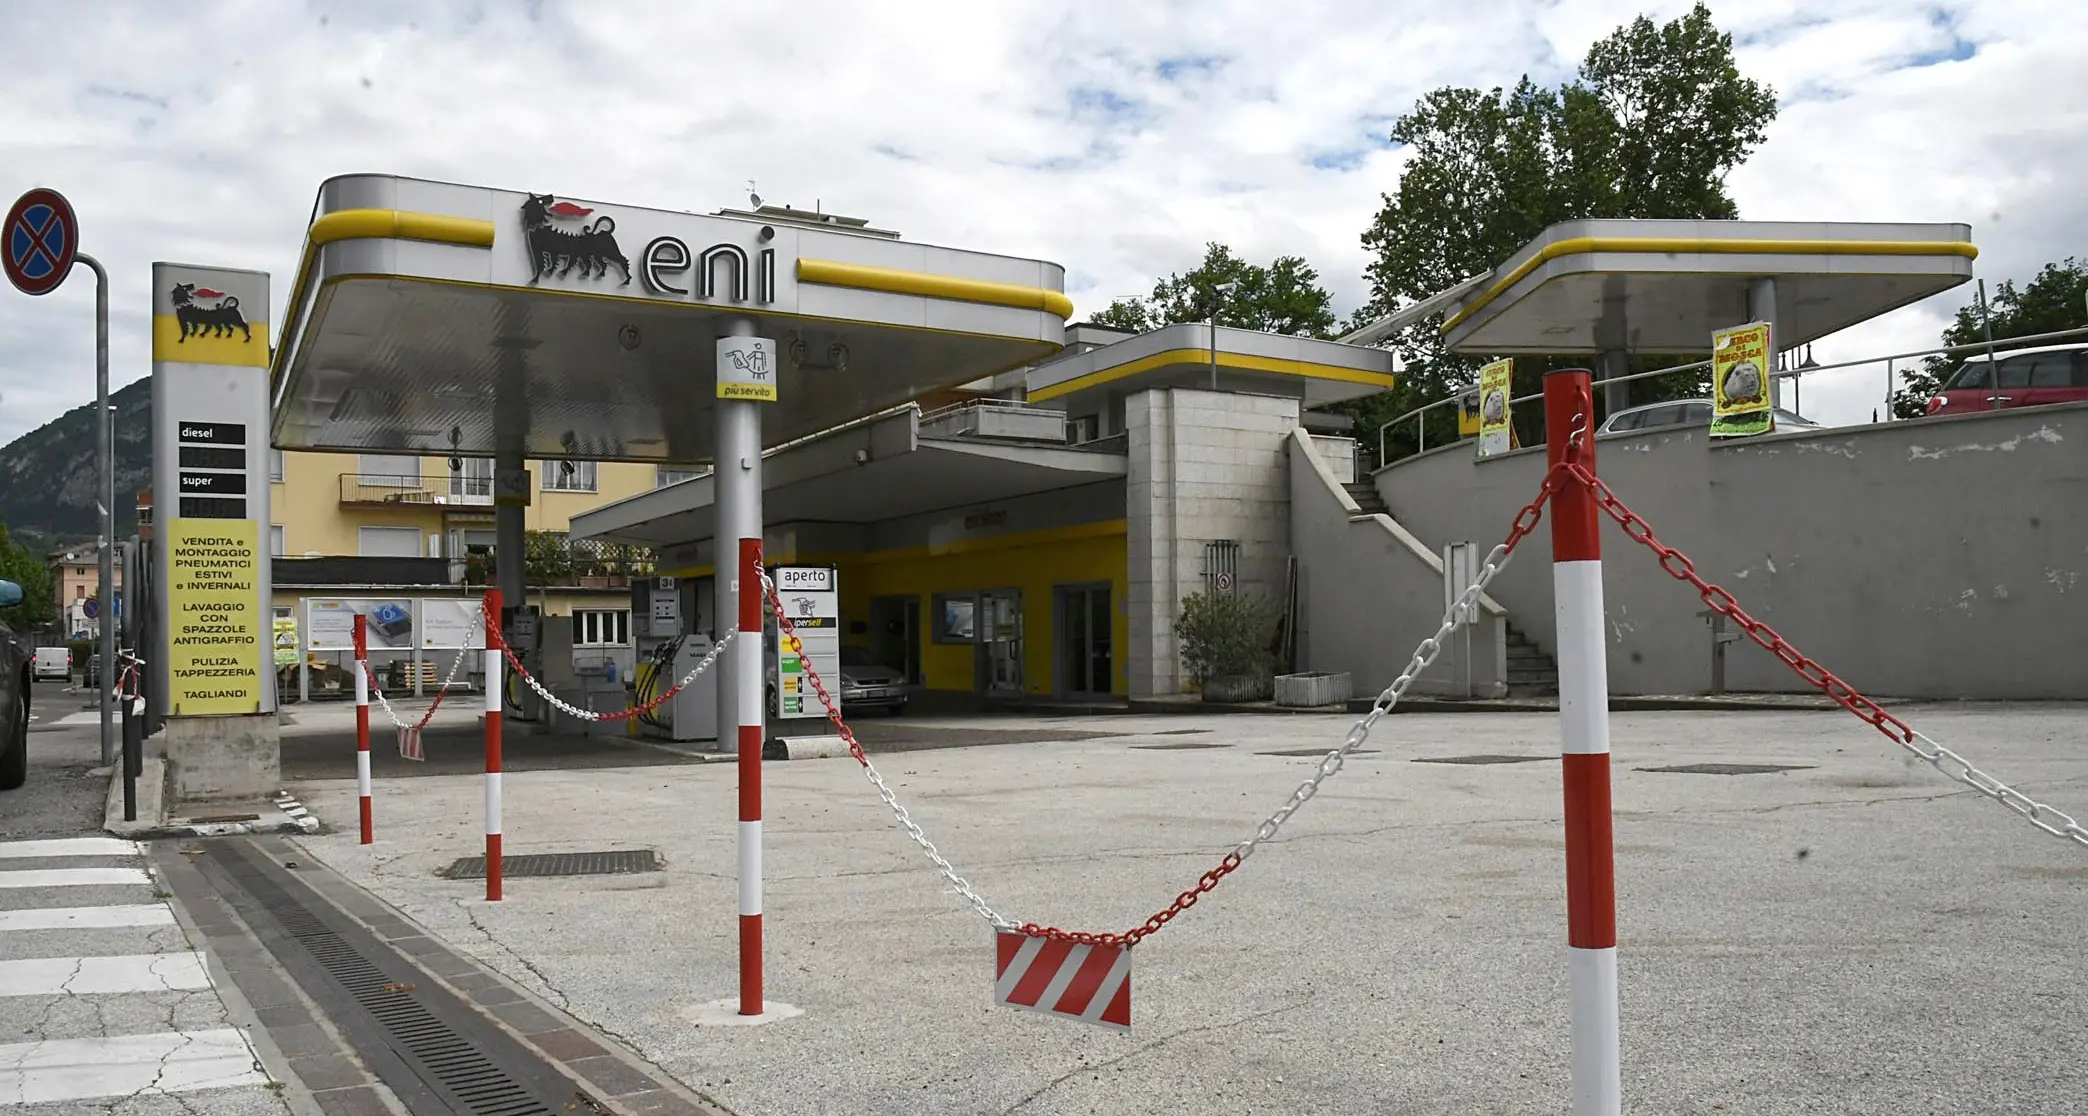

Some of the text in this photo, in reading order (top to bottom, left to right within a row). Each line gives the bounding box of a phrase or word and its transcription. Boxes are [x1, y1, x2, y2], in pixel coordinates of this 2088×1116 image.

[643, 226, 775, 303] eni
[741, 387, 770, 397] servito
[182, 427, 213, 438] diesel
[182, 477, 212, 487] super
[182, 537, 233, 546] VENDITA
[175, 548, 251, 557] MONTAGGIO
[175, 560, 251, 568] PNEUMATICI
[195, 571, 232, 579] ESTIVI
[784, 570, 826, 584] aperto
[187, 582, 251, 590] INVERNALI
[183, 603, 245, 612] LAVAGGIO
[200, 614, 229, 622] CON
[182, 625, 247, 634] SPAZZOLE
[173, 636, 255, 645] ANTIGRAFFIO
[191, 658, 239, 666] PULIZIA
[174, 669, 256, 678] TAPPEZZERIA
[184, 690, 247, 699] TAGLIANDI
